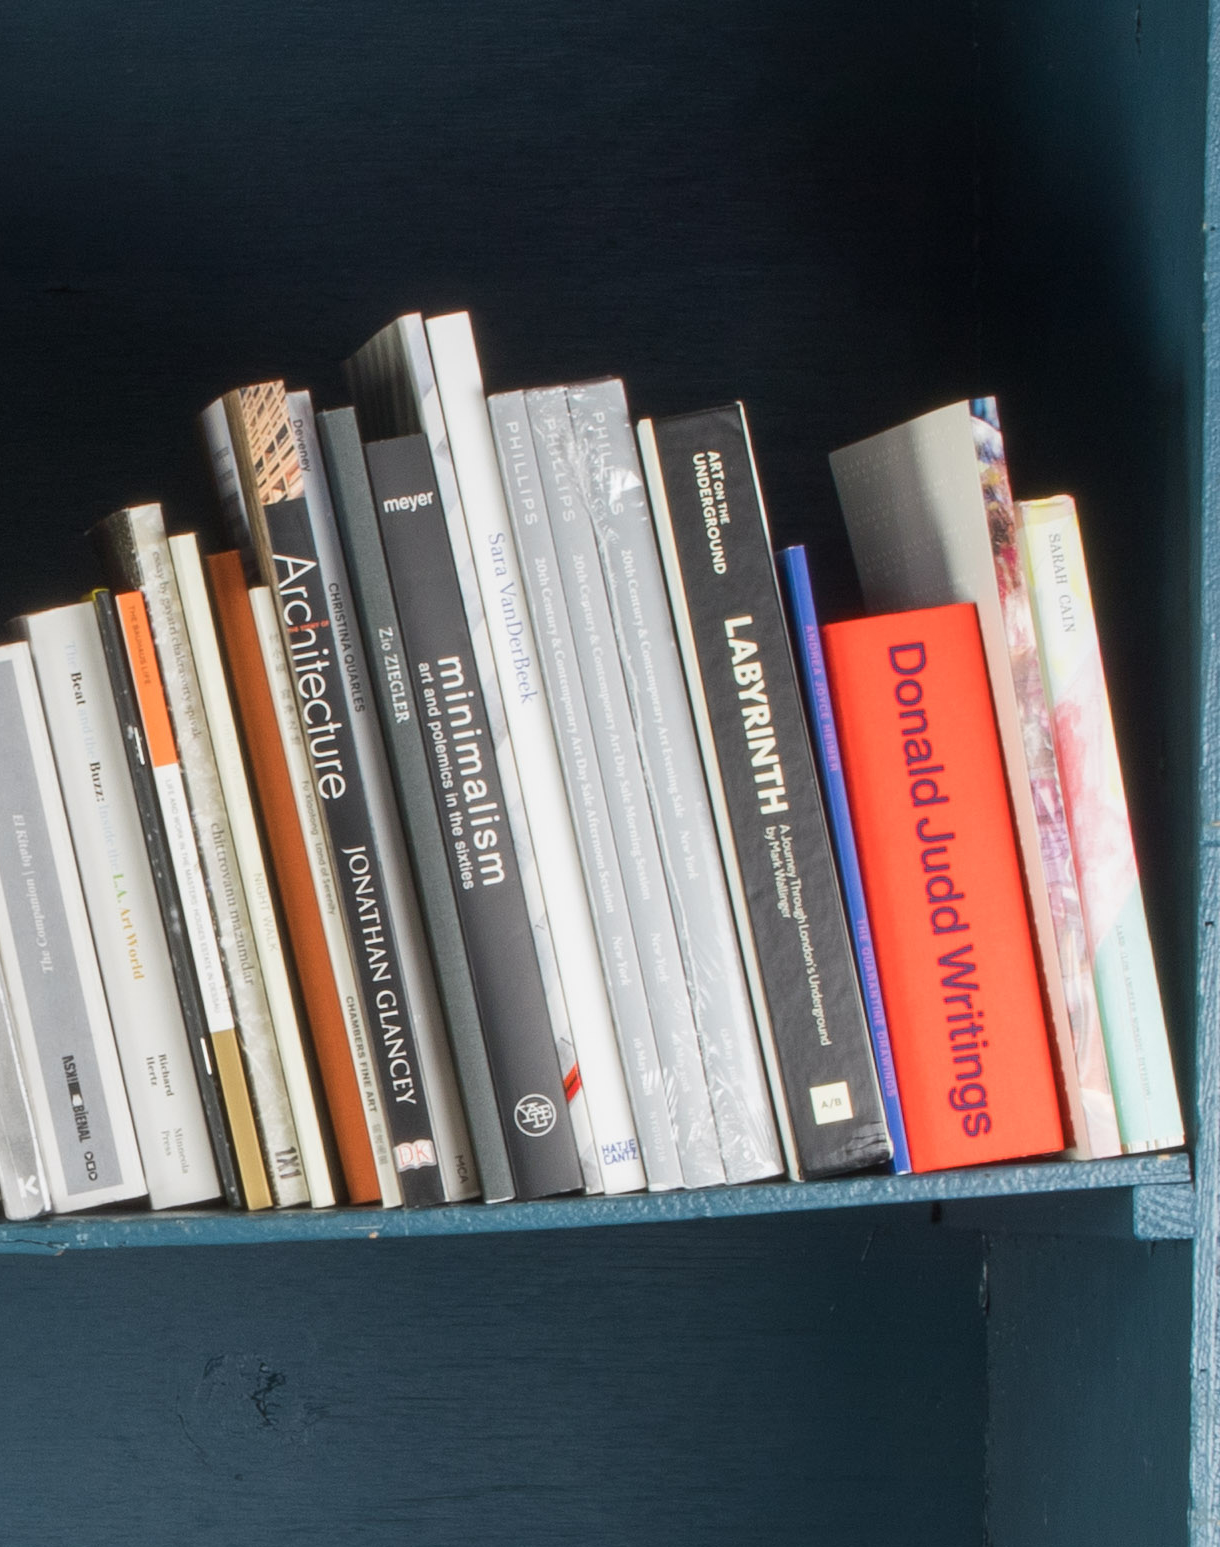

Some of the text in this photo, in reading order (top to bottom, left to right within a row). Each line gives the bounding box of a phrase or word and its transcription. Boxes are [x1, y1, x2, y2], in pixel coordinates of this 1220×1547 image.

[291, 418, 312, 472] Deveney
[706, 449, 731, 525] ART ON THE
[383, 490, 434, 513] meyer
[691, 451, 728, 576] UNDERGROUND
[1046, 533, 1076, 633] SARAH CAIN
[271, 548, 355, 802] Architecture
[327, 581, 367, 713] CHRISTINA QUARLES
[376, 626, 411, 723] Zio ZIEGLER
[722, 613, 788, 816] LABYRINTH
[417, 660, 476, 890] art and polemics in the sixties
[435, 652, 512, 887] minimalism
[763, 824, 794, 919] by Mark Wallinger
[887, 640, 999, 1140] Donald Judd Writings
[340, 843, 393, 984] JONATHAN
[371, 987, 418, 1108] GLANCEY
[345, 994, 367, 1059] CHAMBERS
[358, 1060, 373, 1088] FINE
[364, 1090, 378, 1114] ART
[400, 1144, 430, 1167] DK
[453, 1153, 469, 1185] MCA
